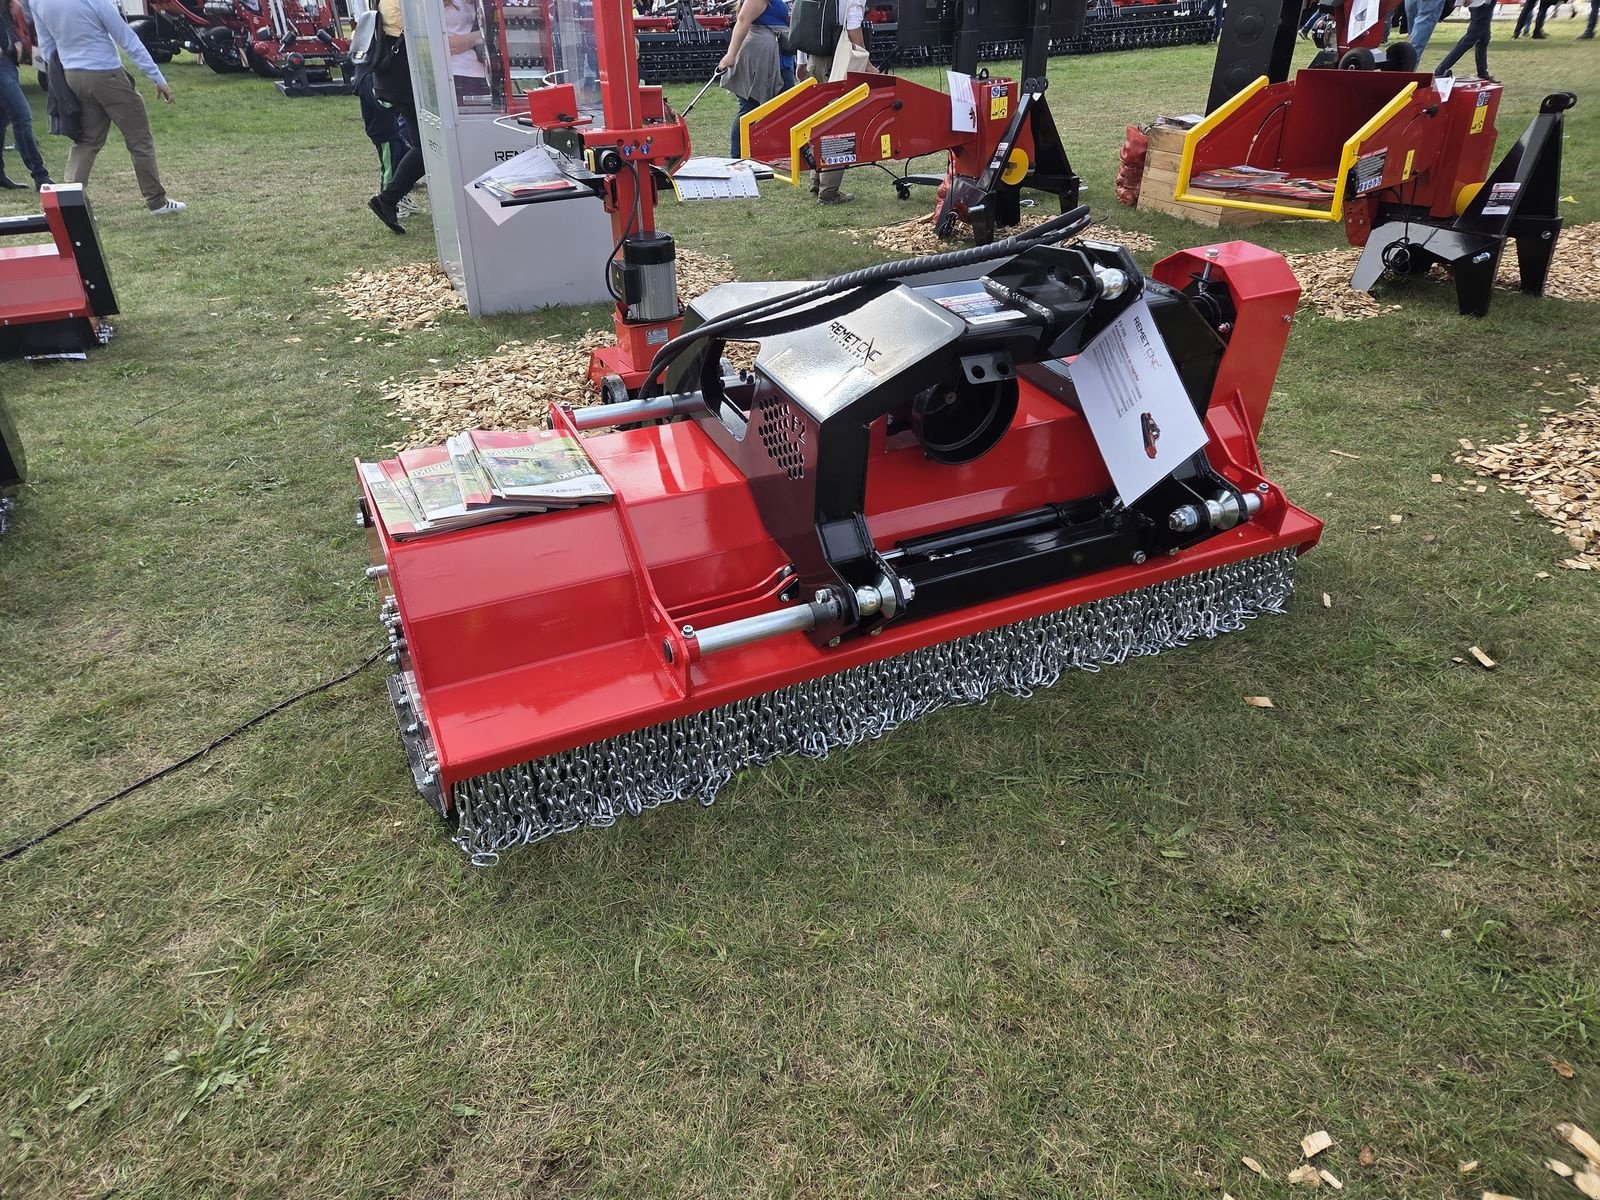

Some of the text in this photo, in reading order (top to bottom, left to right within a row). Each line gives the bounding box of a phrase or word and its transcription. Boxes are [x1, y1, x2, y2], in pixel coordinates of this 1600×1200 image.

[828, 321, 882, 365] REMET CNC
[1133, 315, 1150, 348] REMET
